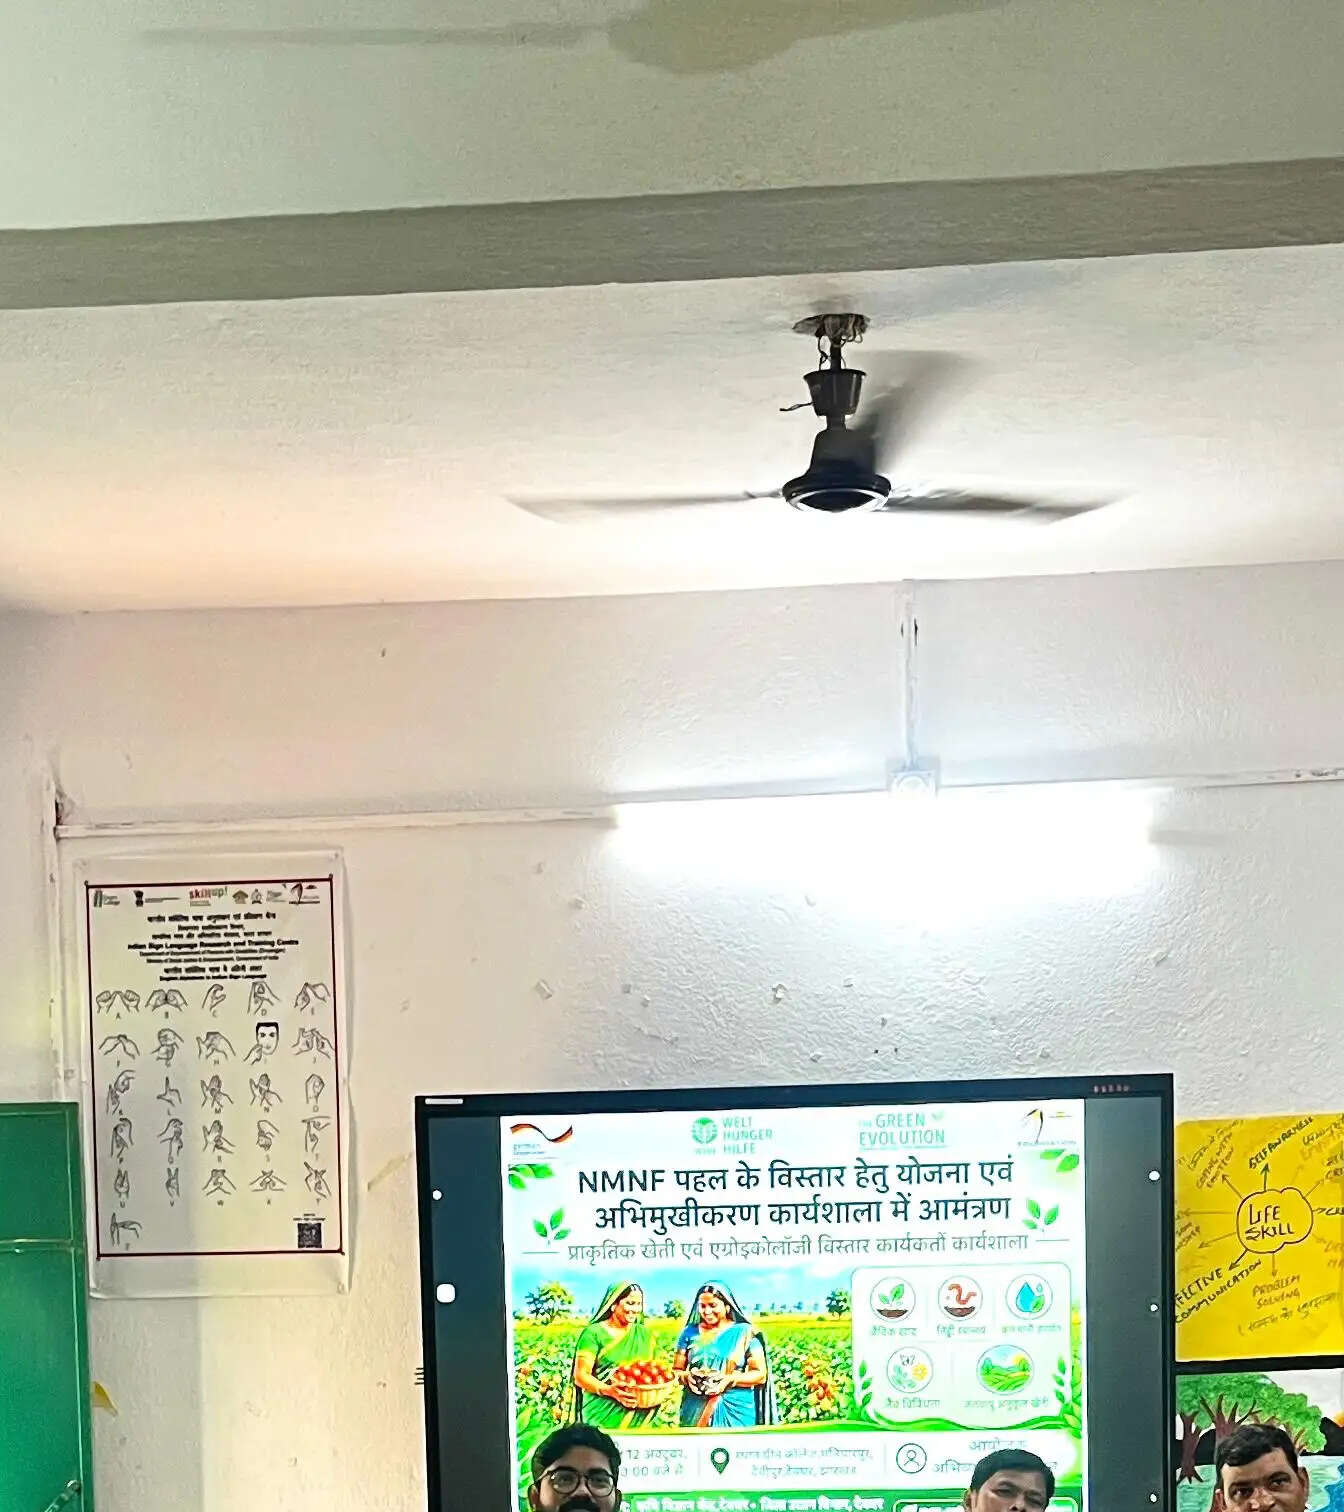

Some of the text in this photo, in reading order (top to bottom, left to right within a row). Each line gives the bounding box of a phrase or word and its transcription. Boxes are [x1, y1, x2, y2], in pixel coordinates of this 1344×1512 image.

[722, 1116, 752, 1129] WELT
[875, 1111, 926, 1129] GREEN
[859, 1129, 946, 1146] EVOLUTION
[579, 1153, 1014, 1194] NMNF पहल के विस्तार हेतु योजना एवं
[595, 1191, 1012, 1236] अभिमुखीकरण कार्यशाला में आमंत्रण
[1249, 1203, 1281, 1225] LIFE
[1245, 1223, 1295, 1241] SKILL
[567, 1239, 637, 1266] प्राकृतिक
[640, 1237, 676, 1260] खेती
[680, 1238, 704, 1260] एवं
[818, 1233, 870, 1255] विस्तार
[951, 1229, 1029, 1252] कार्यशाला
